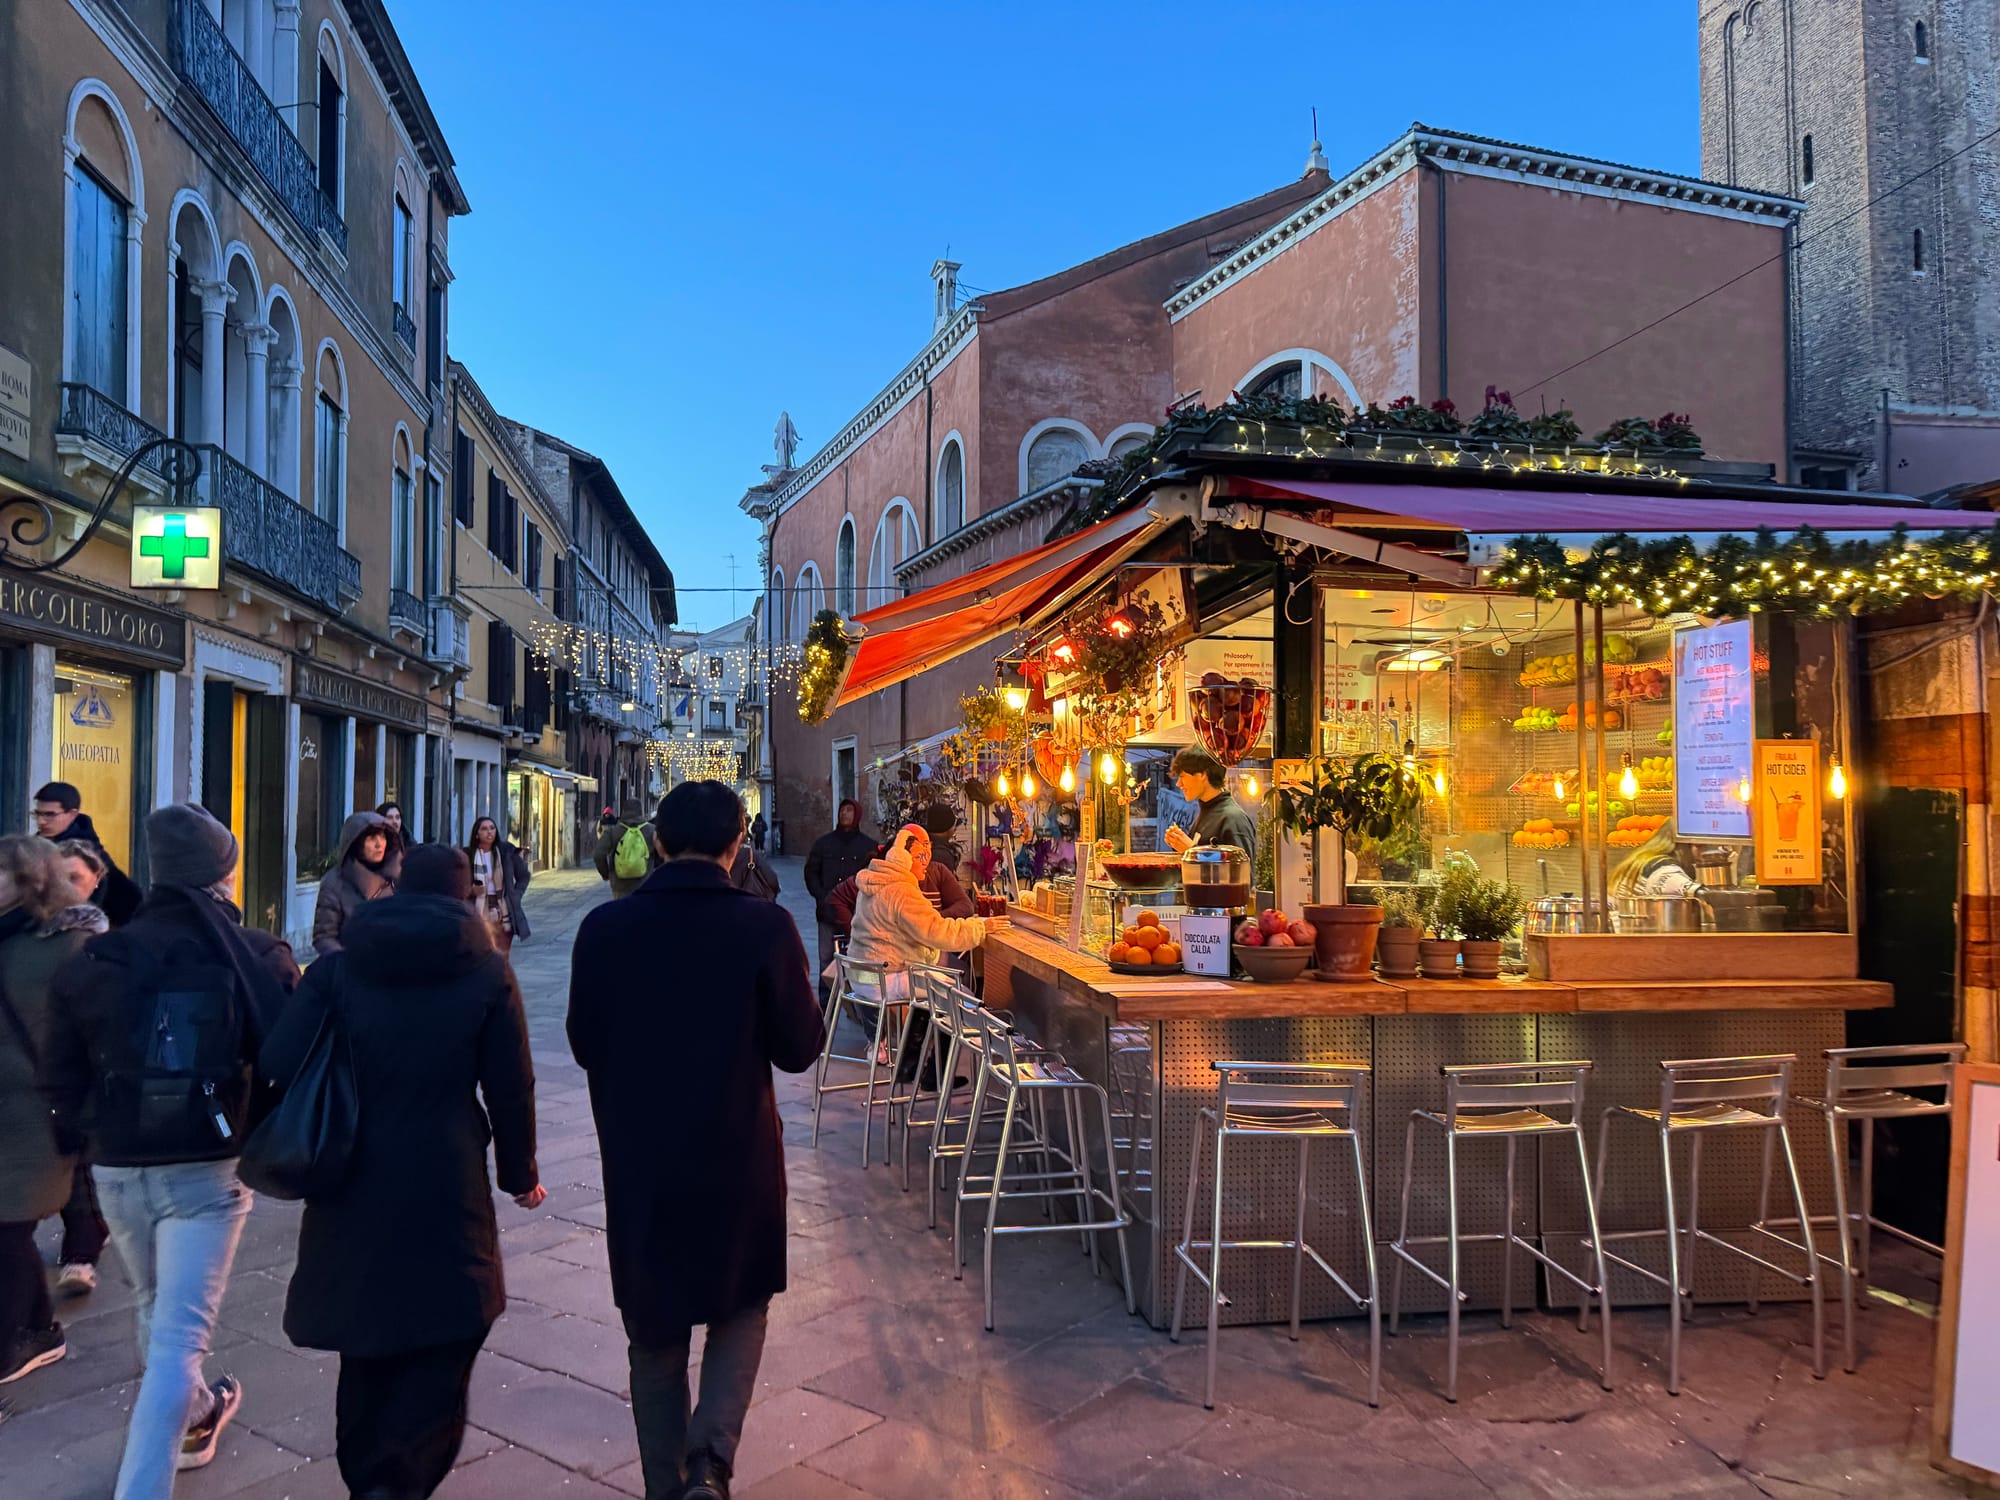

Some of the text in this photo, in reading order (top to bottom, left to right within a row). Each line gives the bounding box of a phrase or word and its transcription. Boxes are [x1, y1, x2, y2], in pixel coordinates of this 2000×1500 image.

[1, 371, 28, 399] ROMA
[1693, 641, 1733, 661] HOT STUFF
[61, 742, 120, 765] OMEOPATIA
[1766, 763, 1806, 775] HOT CIDER
[1184, 933, 1221, 945] CIOCCOLATA
[1190, 944, 1212, 955] CALDA
